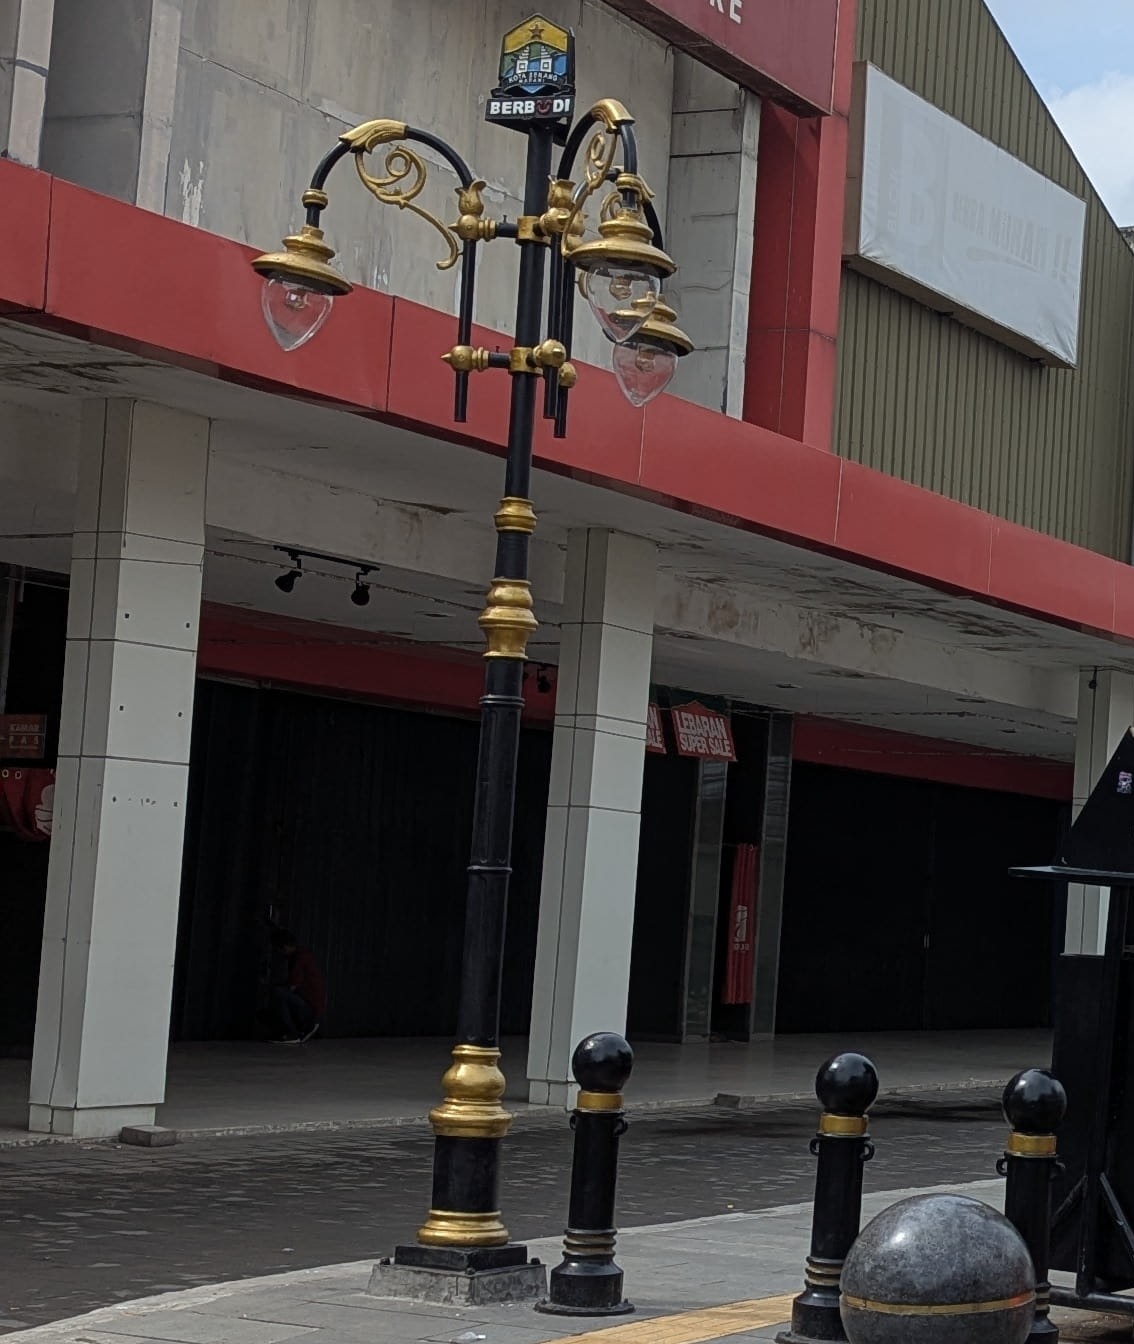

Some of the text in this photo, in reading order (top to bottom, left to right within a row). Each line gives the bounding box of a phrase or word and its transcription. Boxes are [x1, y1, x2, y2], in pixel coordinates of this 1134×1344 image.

[508, 73, 526, 83] KOTA
[673, 710, 728, 739] LEBARAN
[680, 733, 732, 757] SUPER SALE
